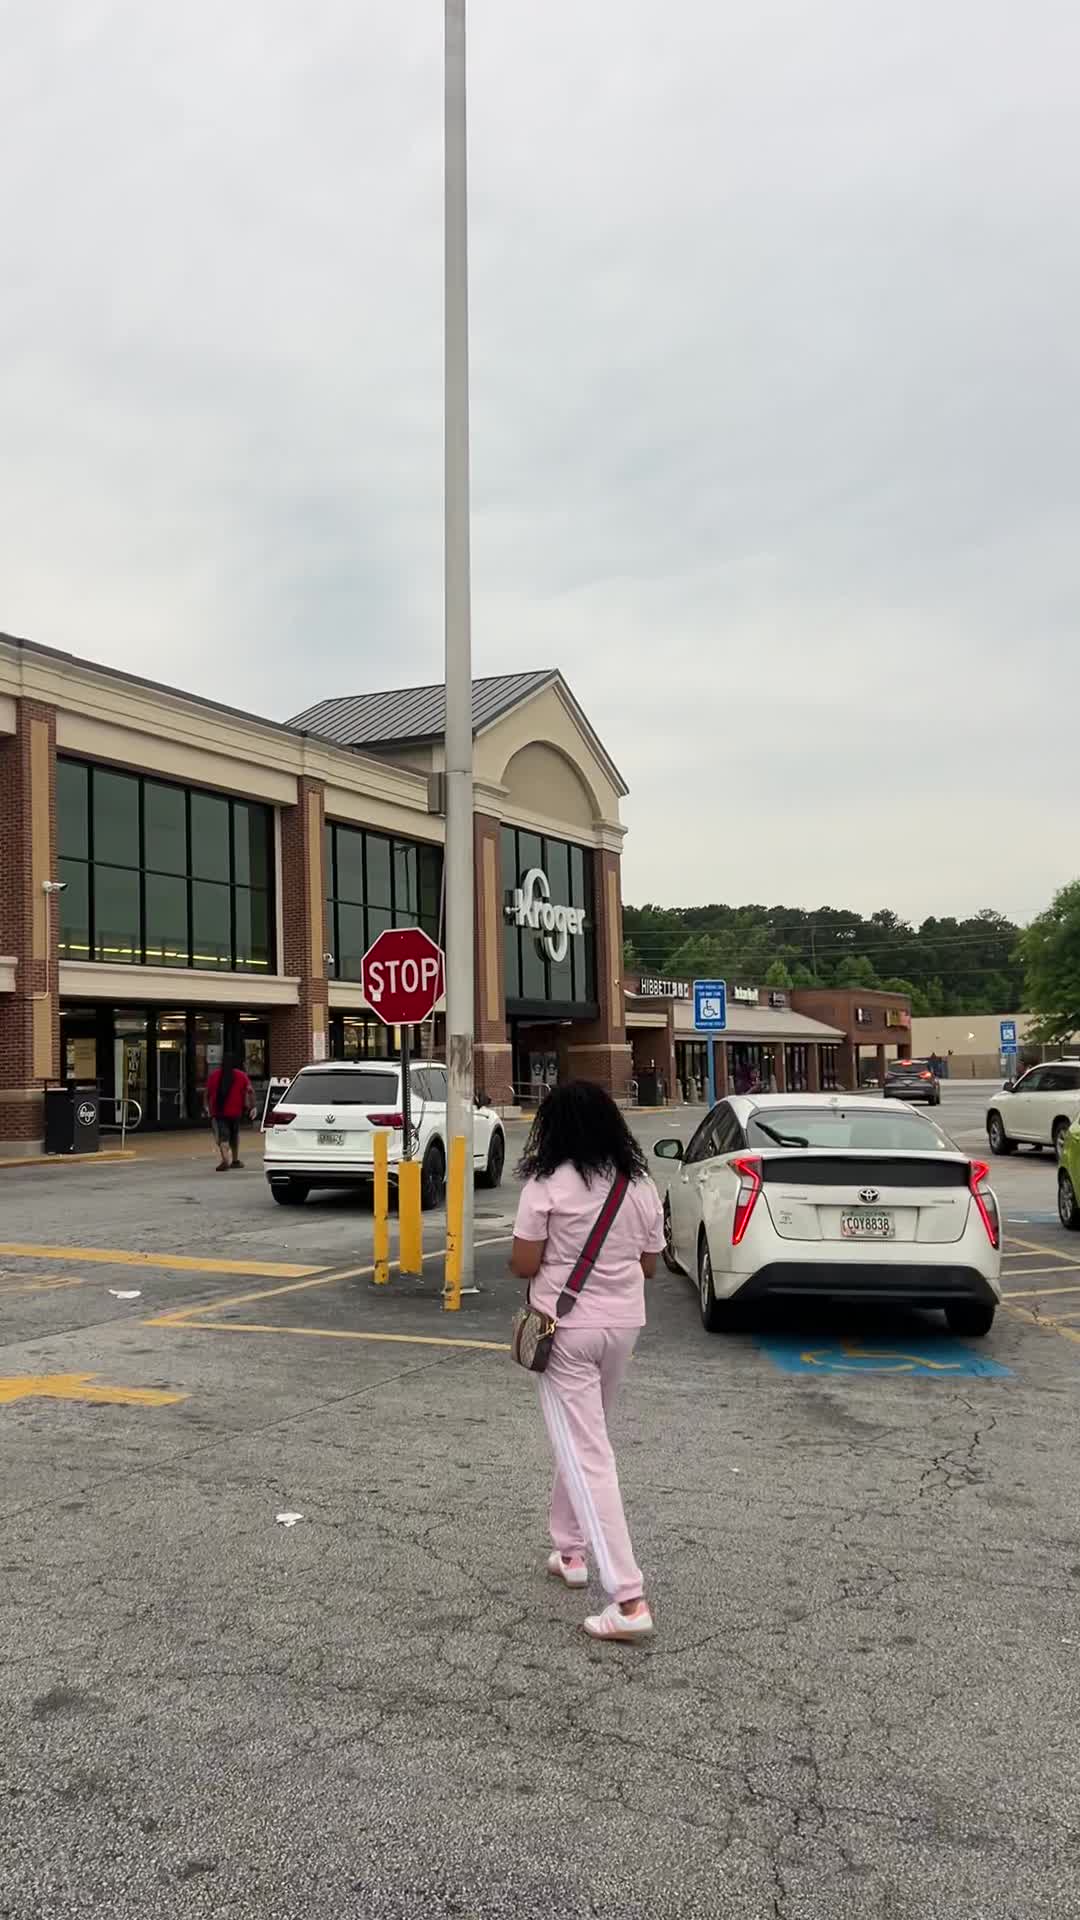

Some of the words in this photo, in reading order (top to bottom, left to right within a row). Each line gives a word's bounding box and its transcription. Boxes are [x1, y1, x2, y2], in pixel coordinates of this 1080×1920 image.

[504, 867, 586, 962] Kroger
[368, 957, 440, 994] STOP
[641, 978, 671, 995] HIBBETT
